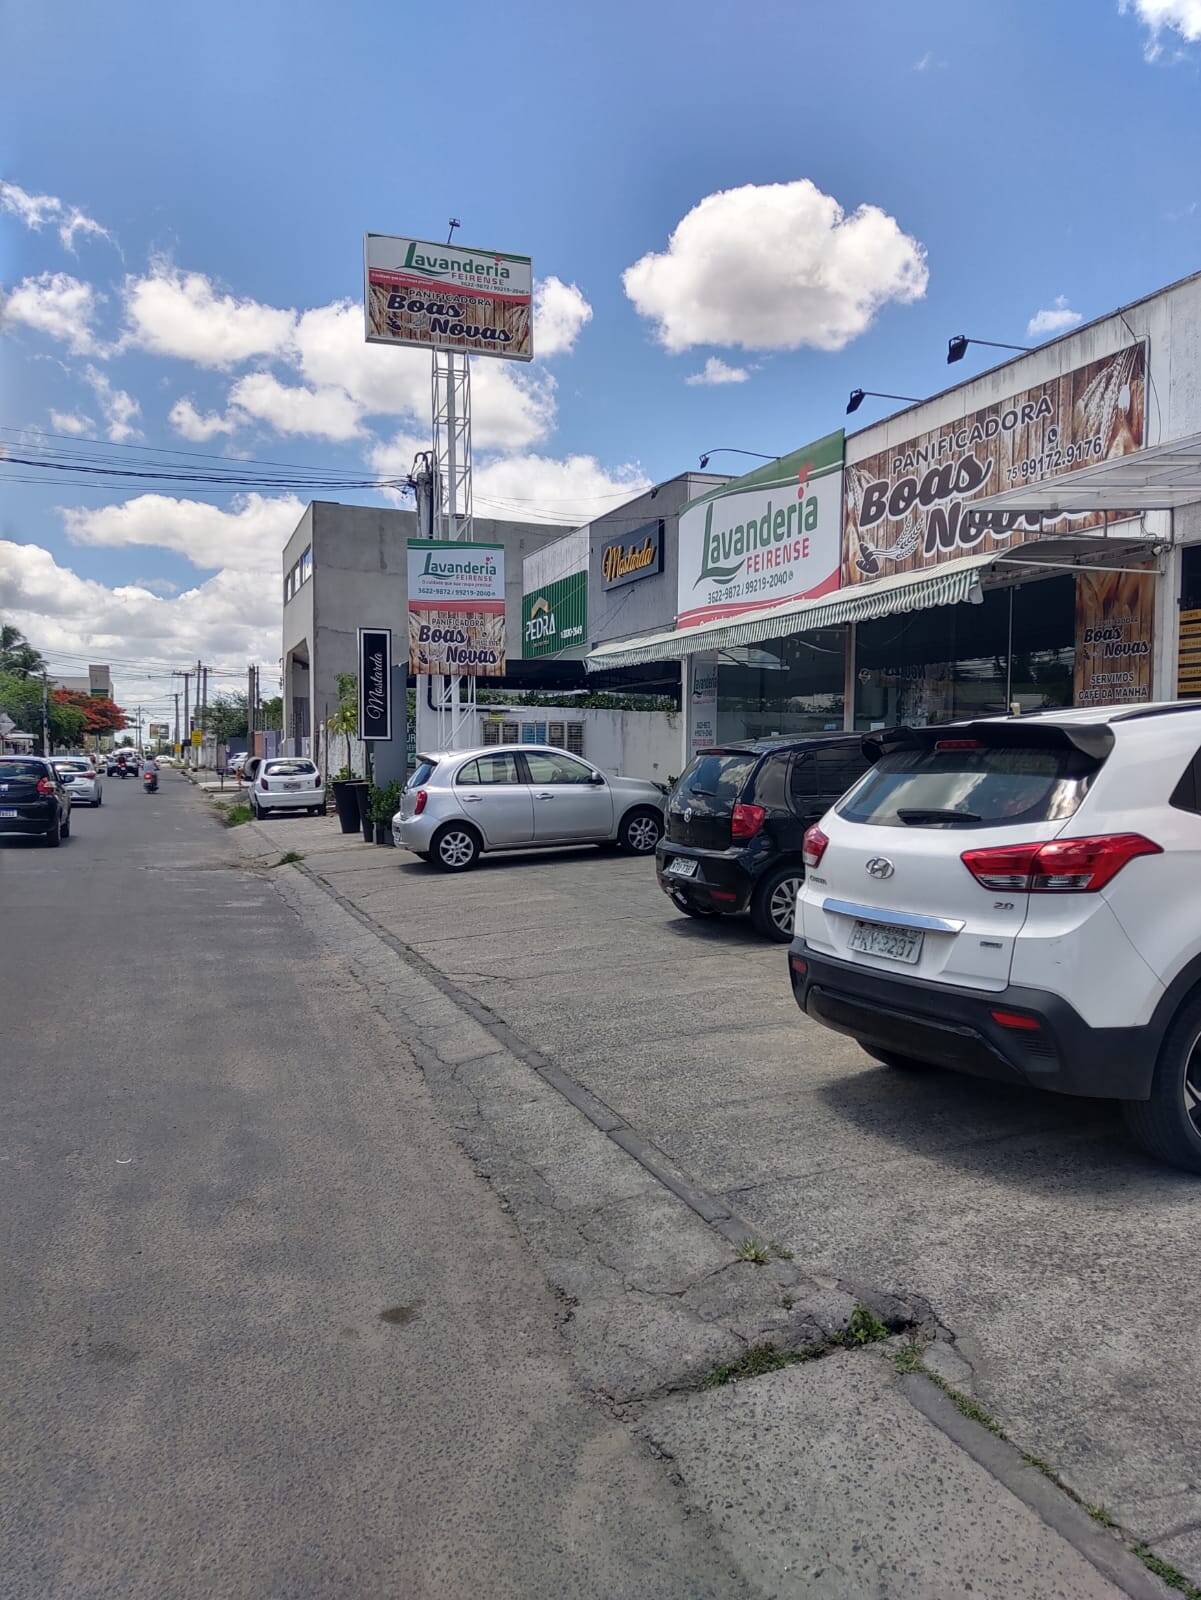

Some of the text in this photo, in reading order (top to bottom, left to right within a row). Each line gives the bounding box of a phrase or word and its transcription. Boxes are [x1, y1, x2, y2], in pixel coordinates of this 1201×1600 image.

[404, 242, 510, 279] Lavanderia
[451, 272, 505, 286] FEIRENSE
[387, 293, 466, 318] Boas
[409, 289, 492, 306] PANIFICADORA
[430, 318, 514, 342] Novas
[892, 396, 1053, 475] PANIFICADORA
[1006, 436, 1102, 480] 75 99172.9176
[859, 454, 993, 528] Boas
[696, 488, 818, 582] Lavanderia
[421, 552, 497, 576] Lavanderia
[602, 538, 657, 582] Mostarda
[746, 537, 810, 574] FEIRENSE
[708, 584, 741, 604] 3622-9872
[745, 571, 788, 595] 99219-2040
[418, 624, 468, 644] Boas
[431, 618, 484, 627] PANIFICADORA
[525, 613, 556, 642] PEDRA
[1084, 627, 1123, 643] Boas
[446, 646, 499, 665] Novas
[1104, 641, 1152, 657] Novas
[366, 652, 385, 720] Mostarda
[1091, 672, 1135, 685] SERVIMOS
[1101, 688, 1114, 699] DA
